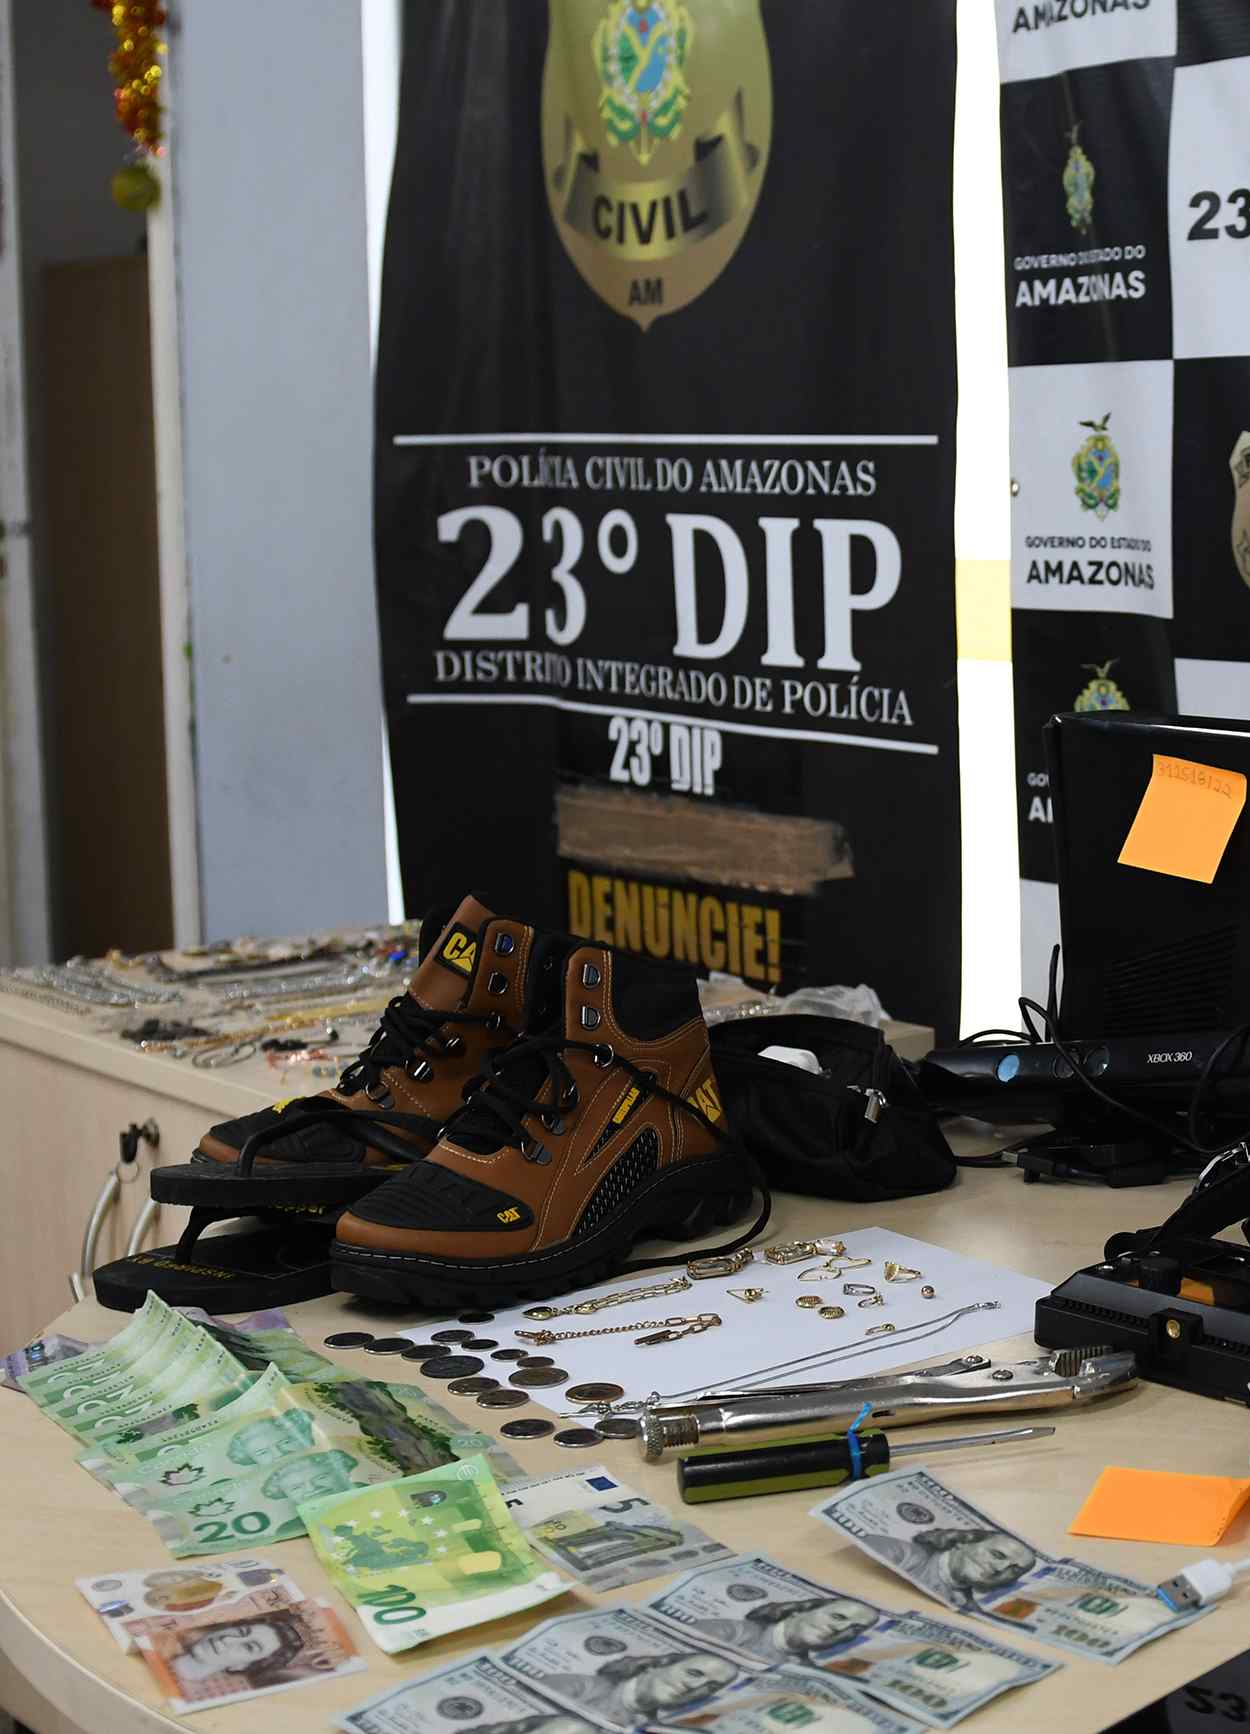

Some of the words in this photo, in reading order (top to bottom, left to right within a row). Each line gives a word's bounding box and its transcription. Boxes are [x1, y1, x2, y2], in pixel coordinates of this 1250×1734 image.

[592, 189, 710, 246] CIVIL
[1124, 245, 1146, 260] DO
[627, 278, 664, 307] AM
[1015, 270, 1146, 307] AMAZONAS
[585, 457, 652, 491] CIVIL
[656, 457, 693, 492] DO
[700, 460, 876, 496] AMAZONAS
[1025, 535, 1085, 549] GOVERNO
[1089, 536, 1107, 549] DO
[665, 513, 903, 672] DIP
[1027, 560, 1154, 590] AMAZONAS
[577, 659, 727, 707] INTEGRADO
[734, 677, 774, 712] DE
[782, 677, 914, 726] POLÍCIA
[670, 724, 723, 796] DIP
[443, 932, 477, 973] CA
[1146, 1053, 1173, 1063] XBOX
[1173, 1051, 1193, 1062] 360
[193, 1510, 271, 1545] 20
